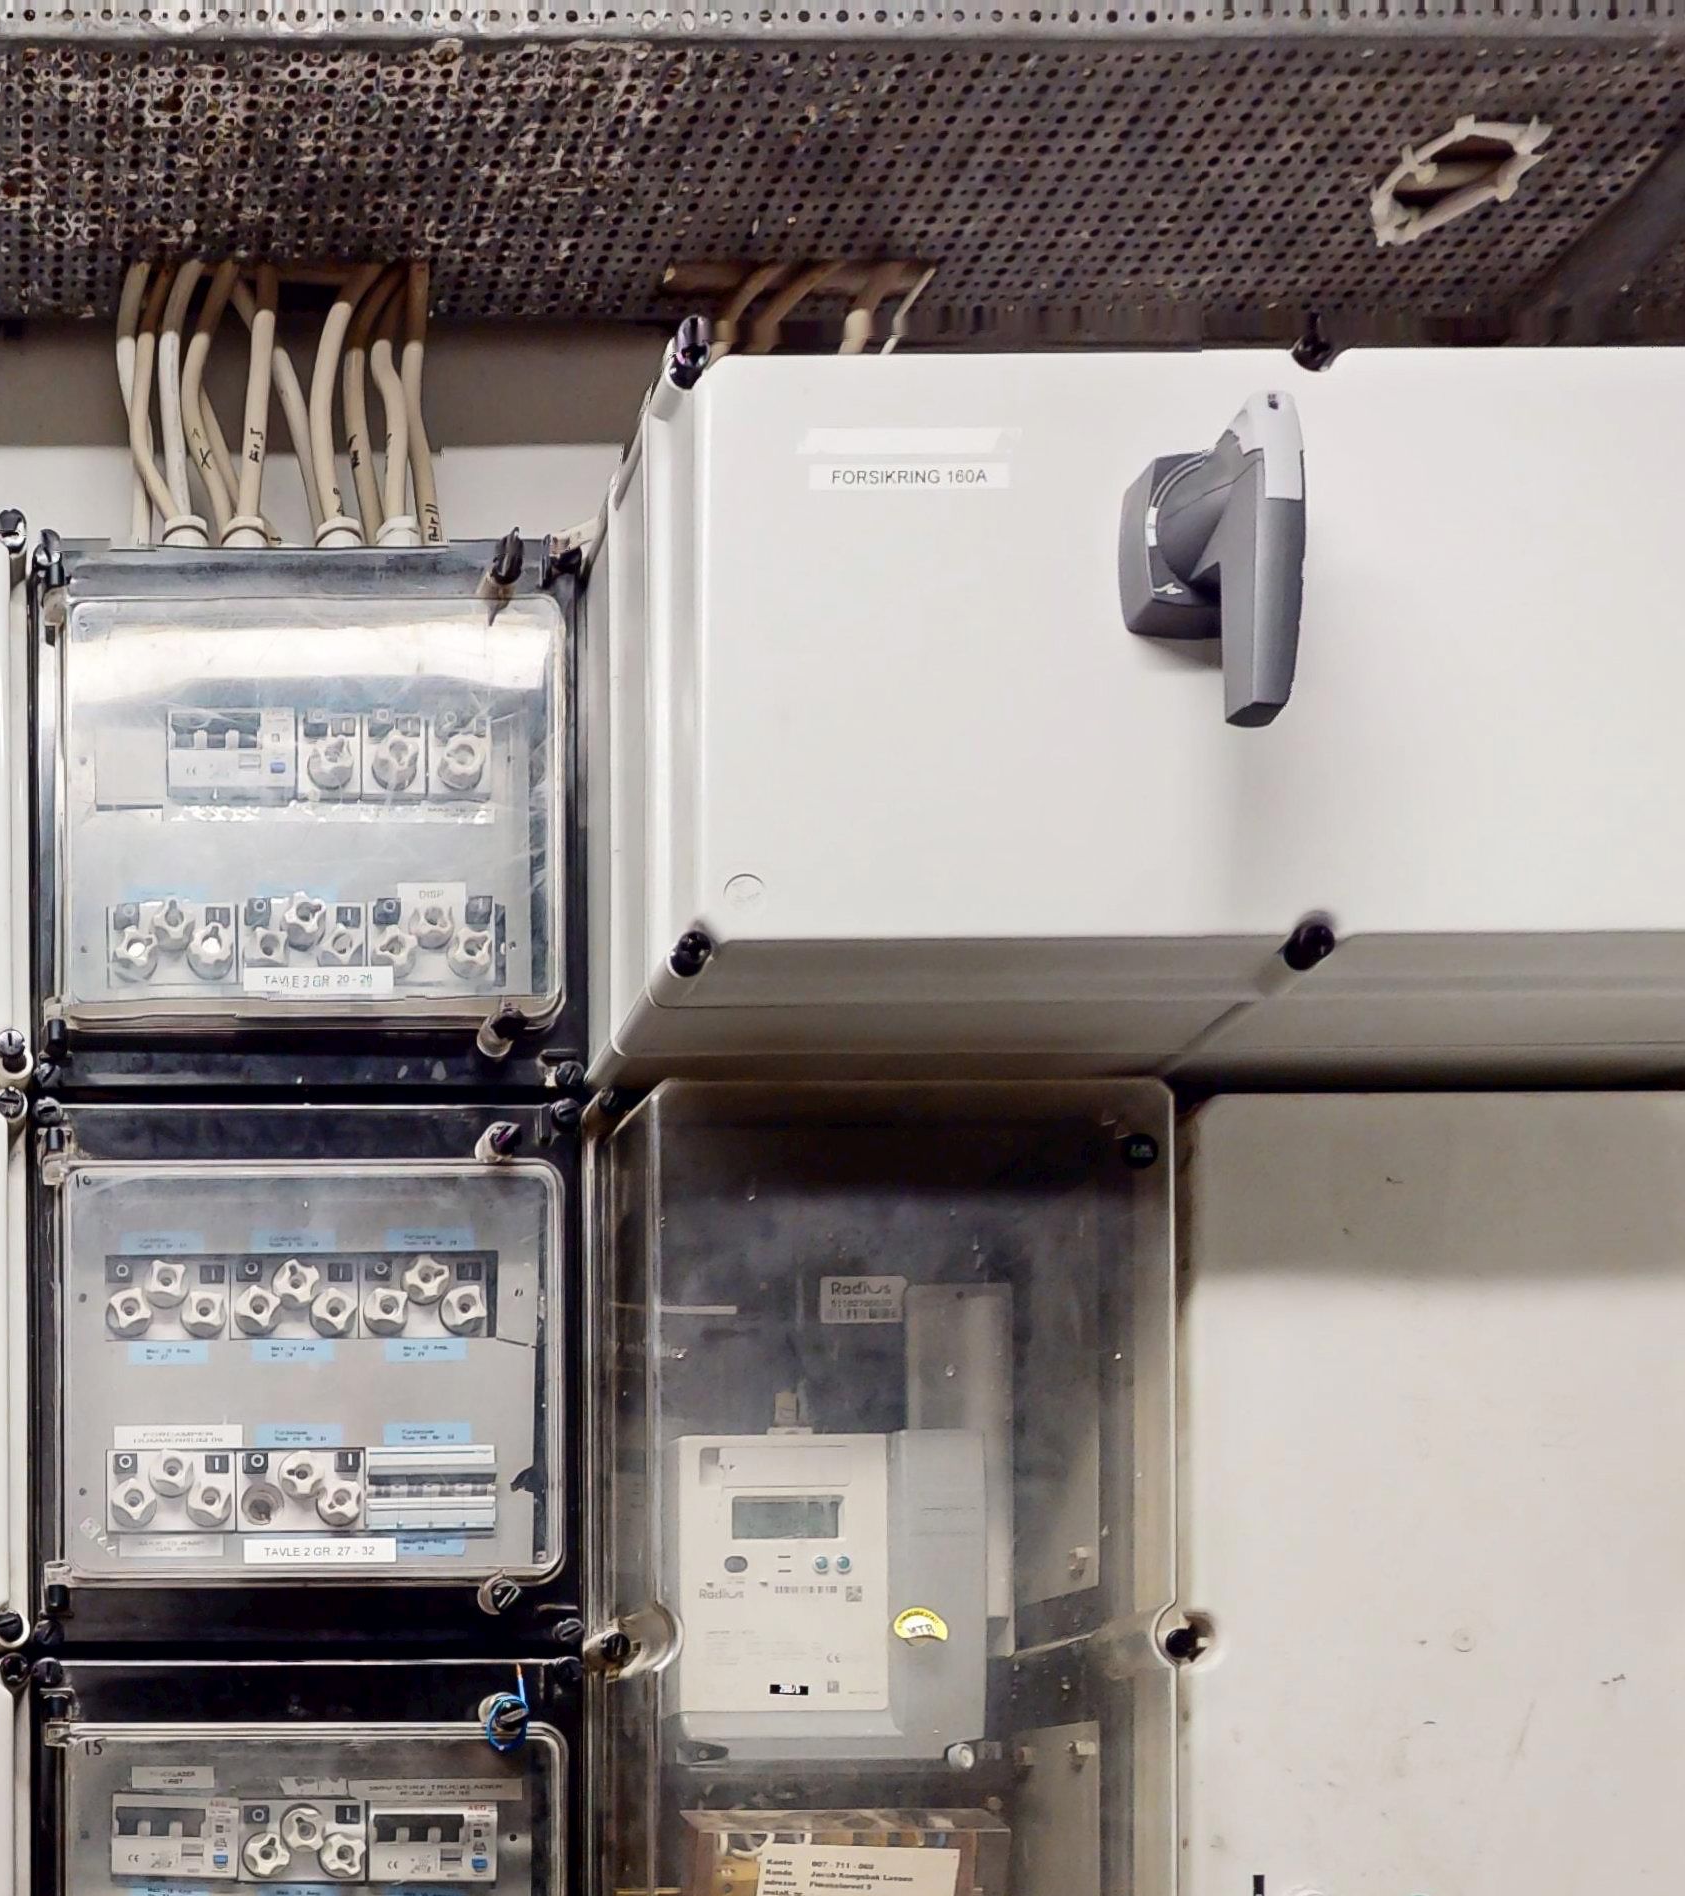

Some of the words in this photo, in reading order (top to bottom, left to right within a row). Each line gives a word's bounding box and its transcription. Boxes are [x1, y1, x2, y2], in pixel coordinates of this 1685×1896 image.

[830, 468, 941, 486] FORSIKRING
[946, 467, 988, 484] 160A
[830, 1281, 892, 1296] Radius
[263, 1546, 300, 1558] TAVLE
[302, 1546, 311, 1557] 2
[337, 1545, 352, 1557] 27
[360, 1545, 375, 1556] 32
[698, 1586, 745, 1600] Radius
[83, 1738, 104, 1757] 15
